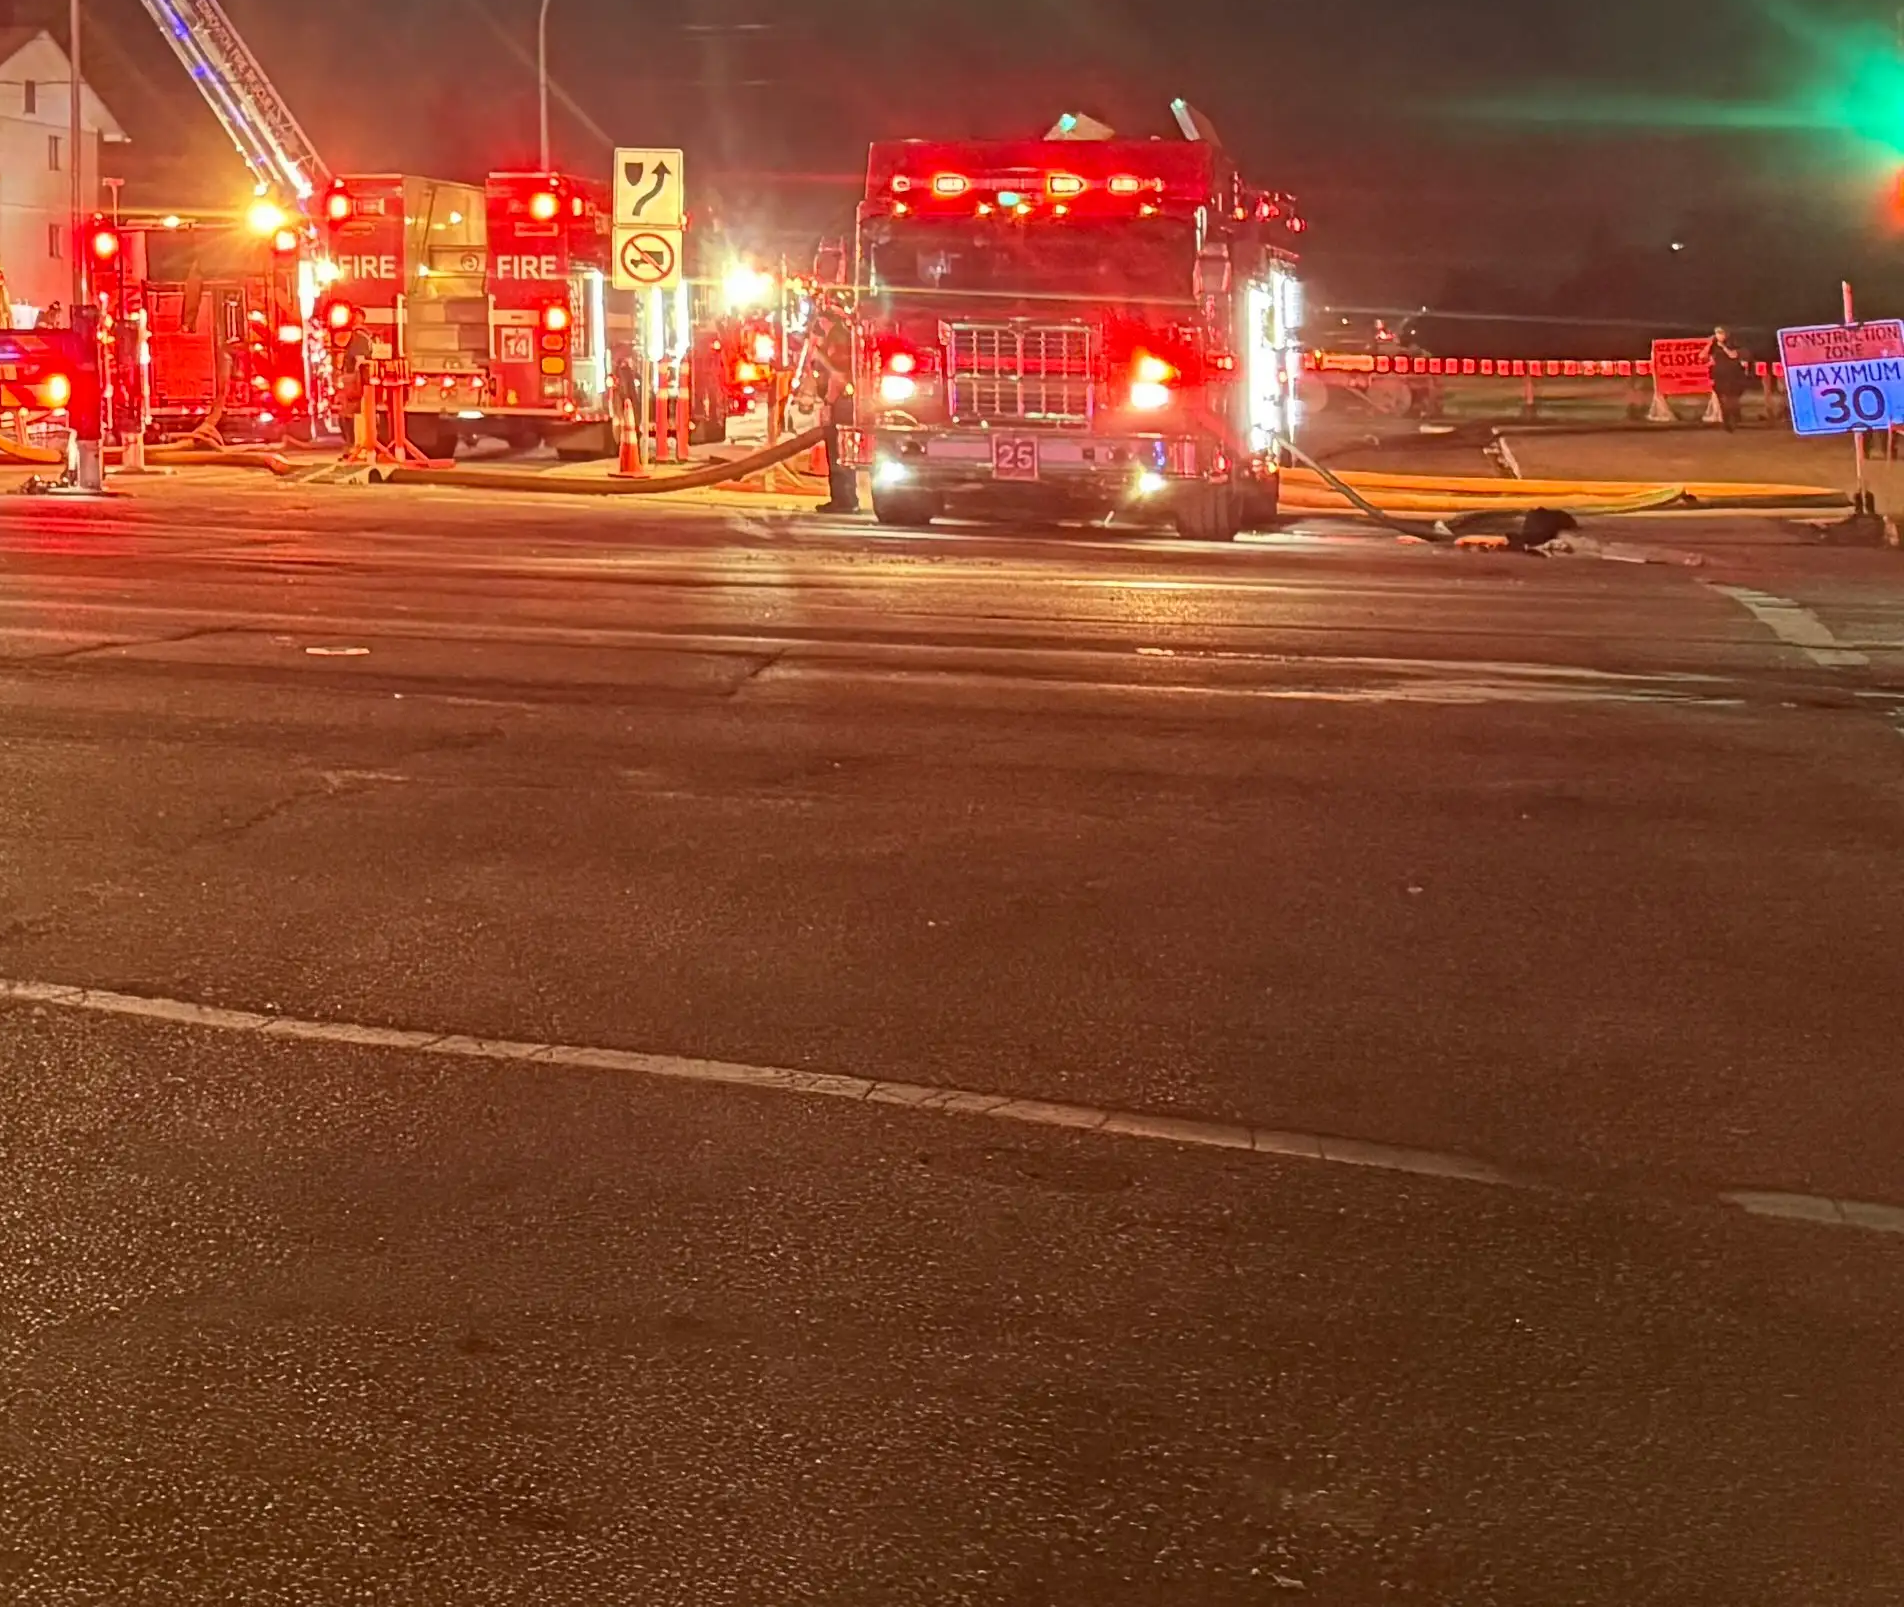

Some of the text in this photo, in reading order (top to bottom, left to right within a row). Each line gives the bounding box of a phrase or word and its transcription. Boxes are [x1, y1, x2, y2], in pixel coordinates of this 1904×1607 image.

[338, 254, 397, 279] FIRE
[496, 254, 557, 280] FIRE
[505, 337, 527, 356] 14
[1785, 325, 1898, 348] CONSTRUCTION
[1824, 343, 1865, 360] ZONE
[1795, 361, 1902, 388] MAXIMUM
[1820, 384, 1886, 424] 30
[998, 444, 1033, 470] 25
